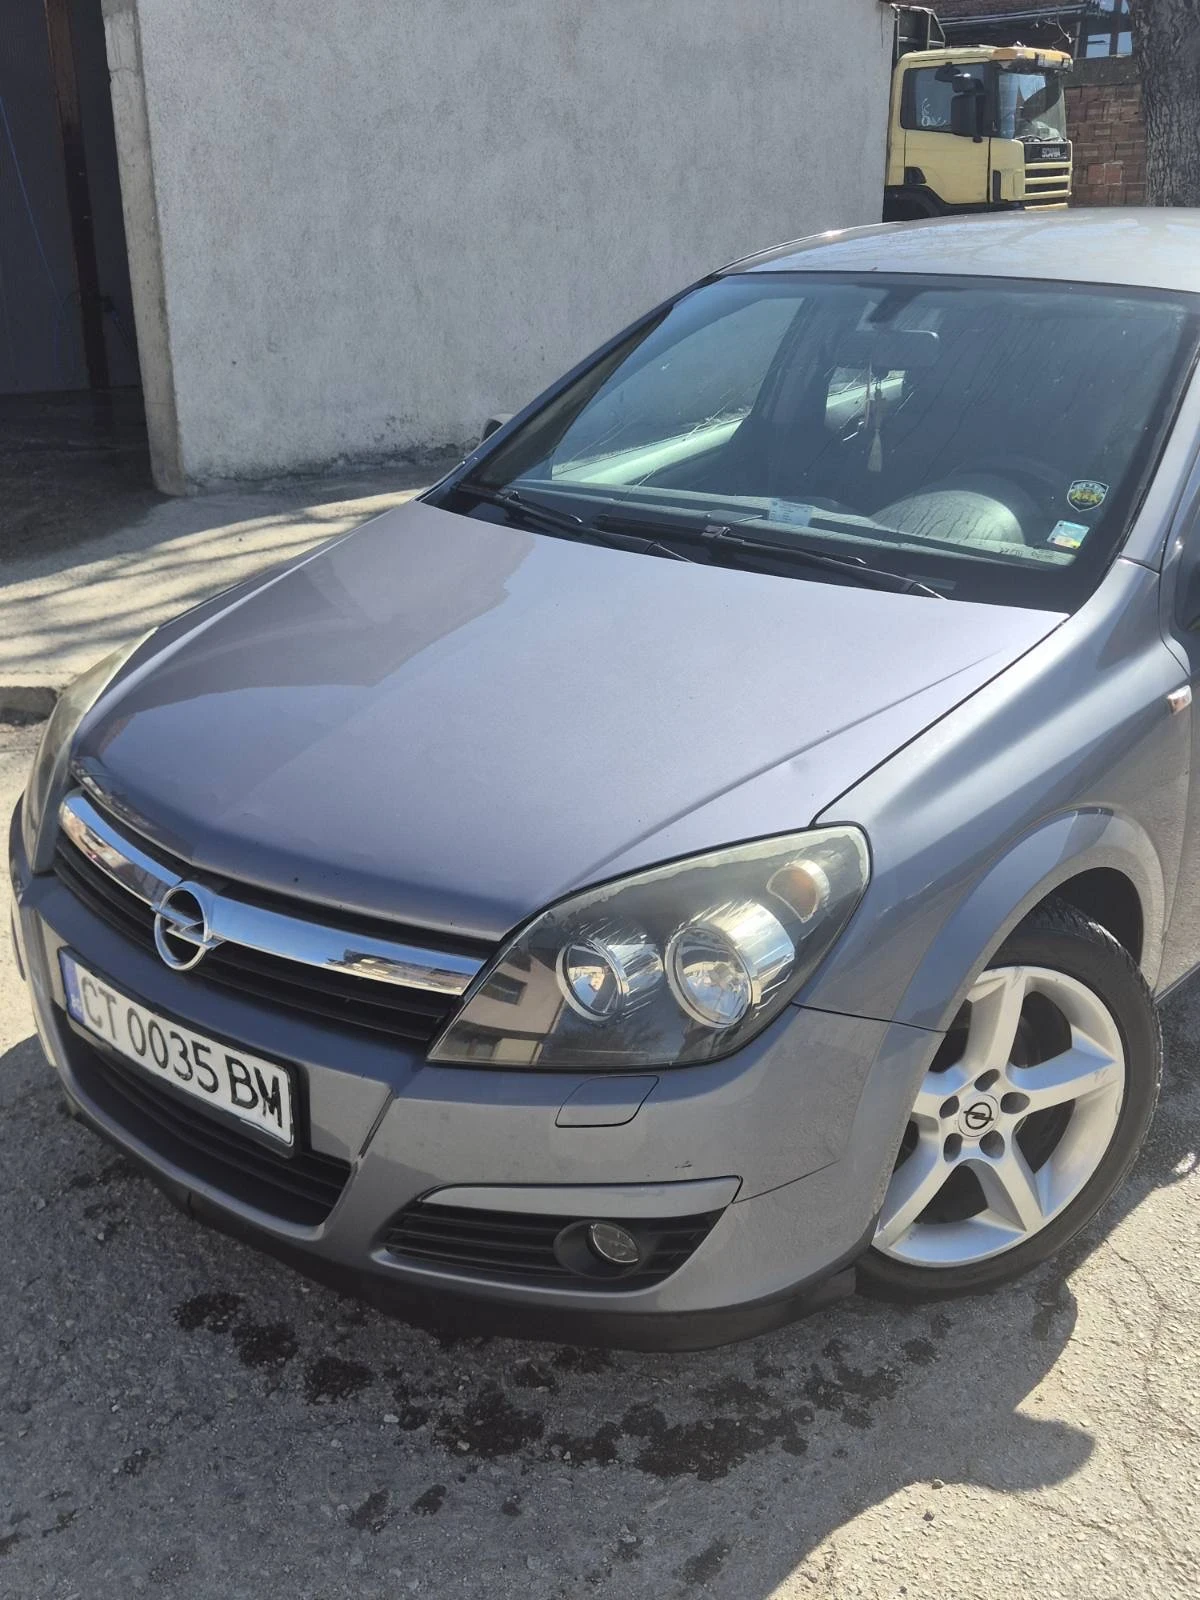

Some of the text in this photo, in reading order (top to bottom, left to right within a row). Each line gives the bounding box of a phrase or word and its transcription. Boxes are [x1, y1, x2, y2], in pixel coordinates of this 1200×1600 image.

[81, 976, 283, 1128] CT 0035 BM
